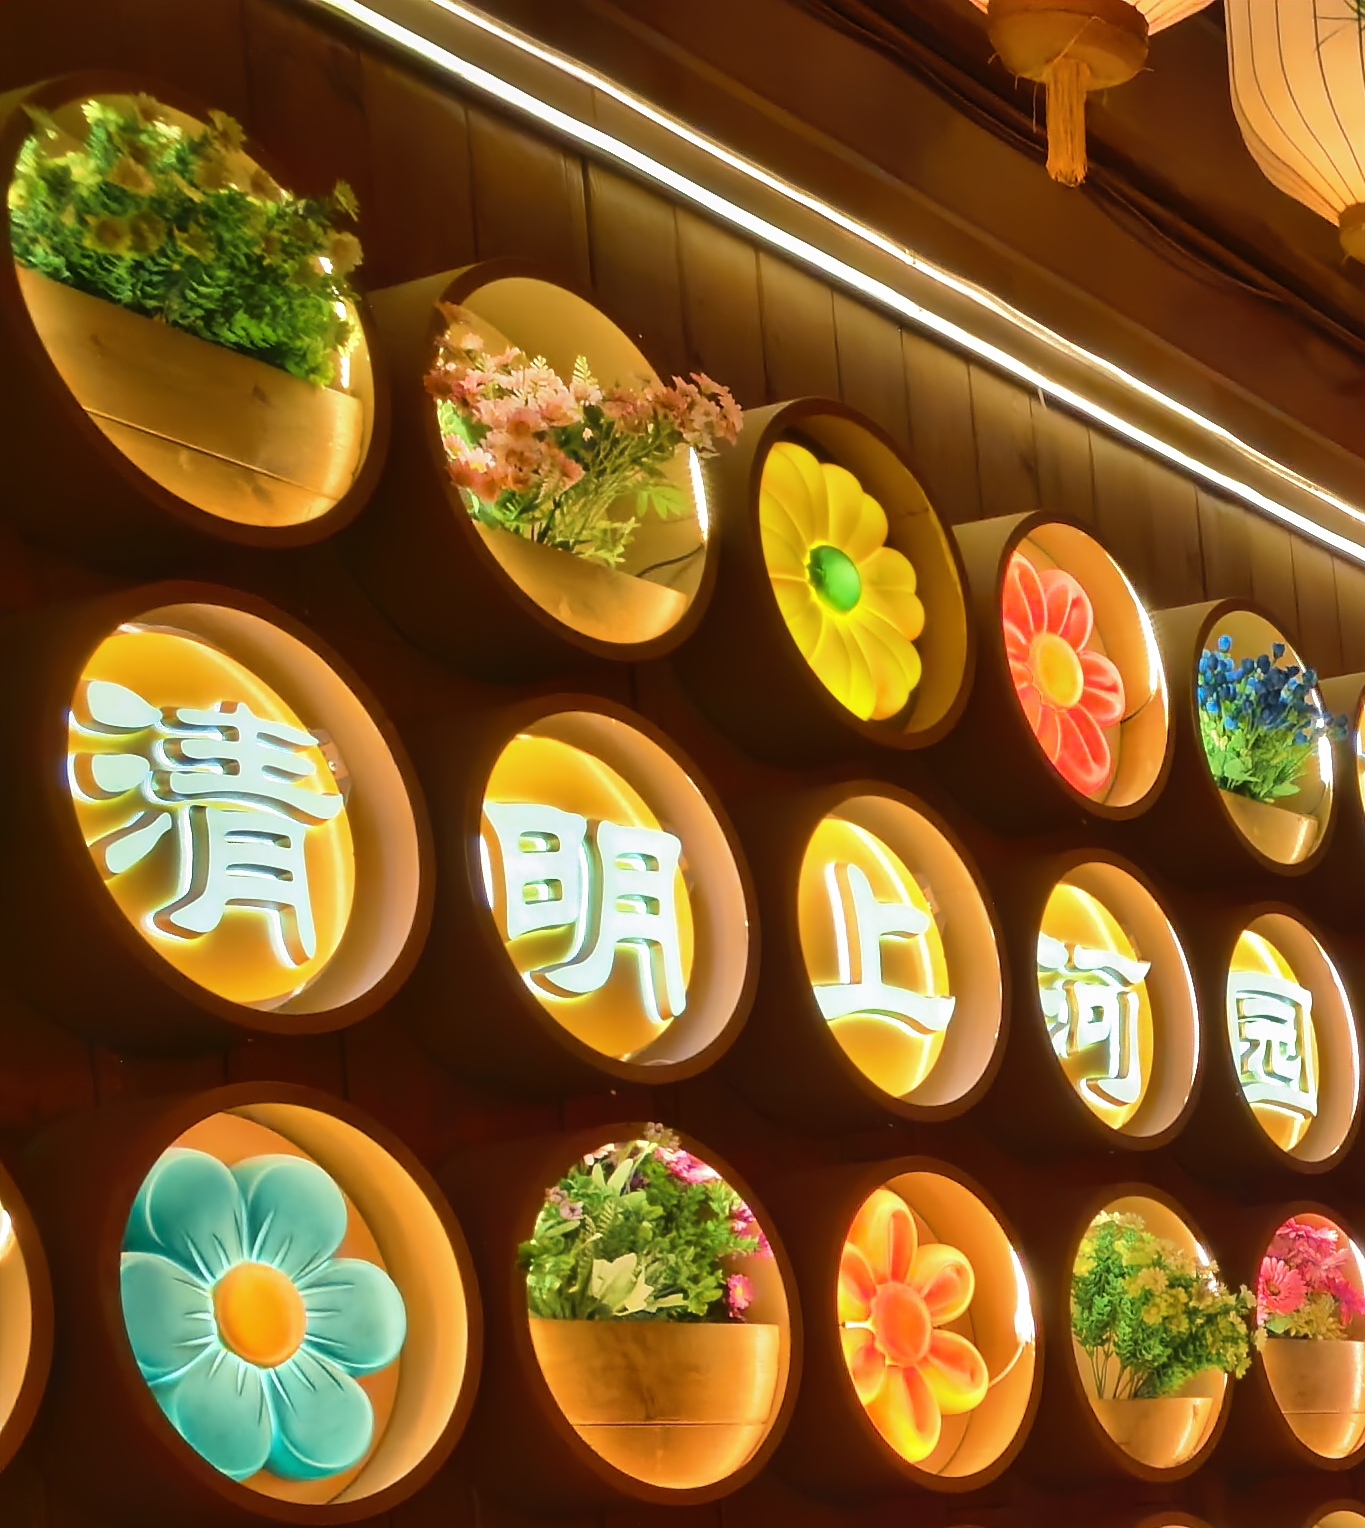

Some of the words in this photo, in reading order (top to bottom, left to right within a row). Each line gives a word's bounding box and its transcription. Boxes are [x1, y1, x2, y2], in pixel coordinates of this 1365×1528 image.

[66, 681, 1314, 1121] 清明上河园
